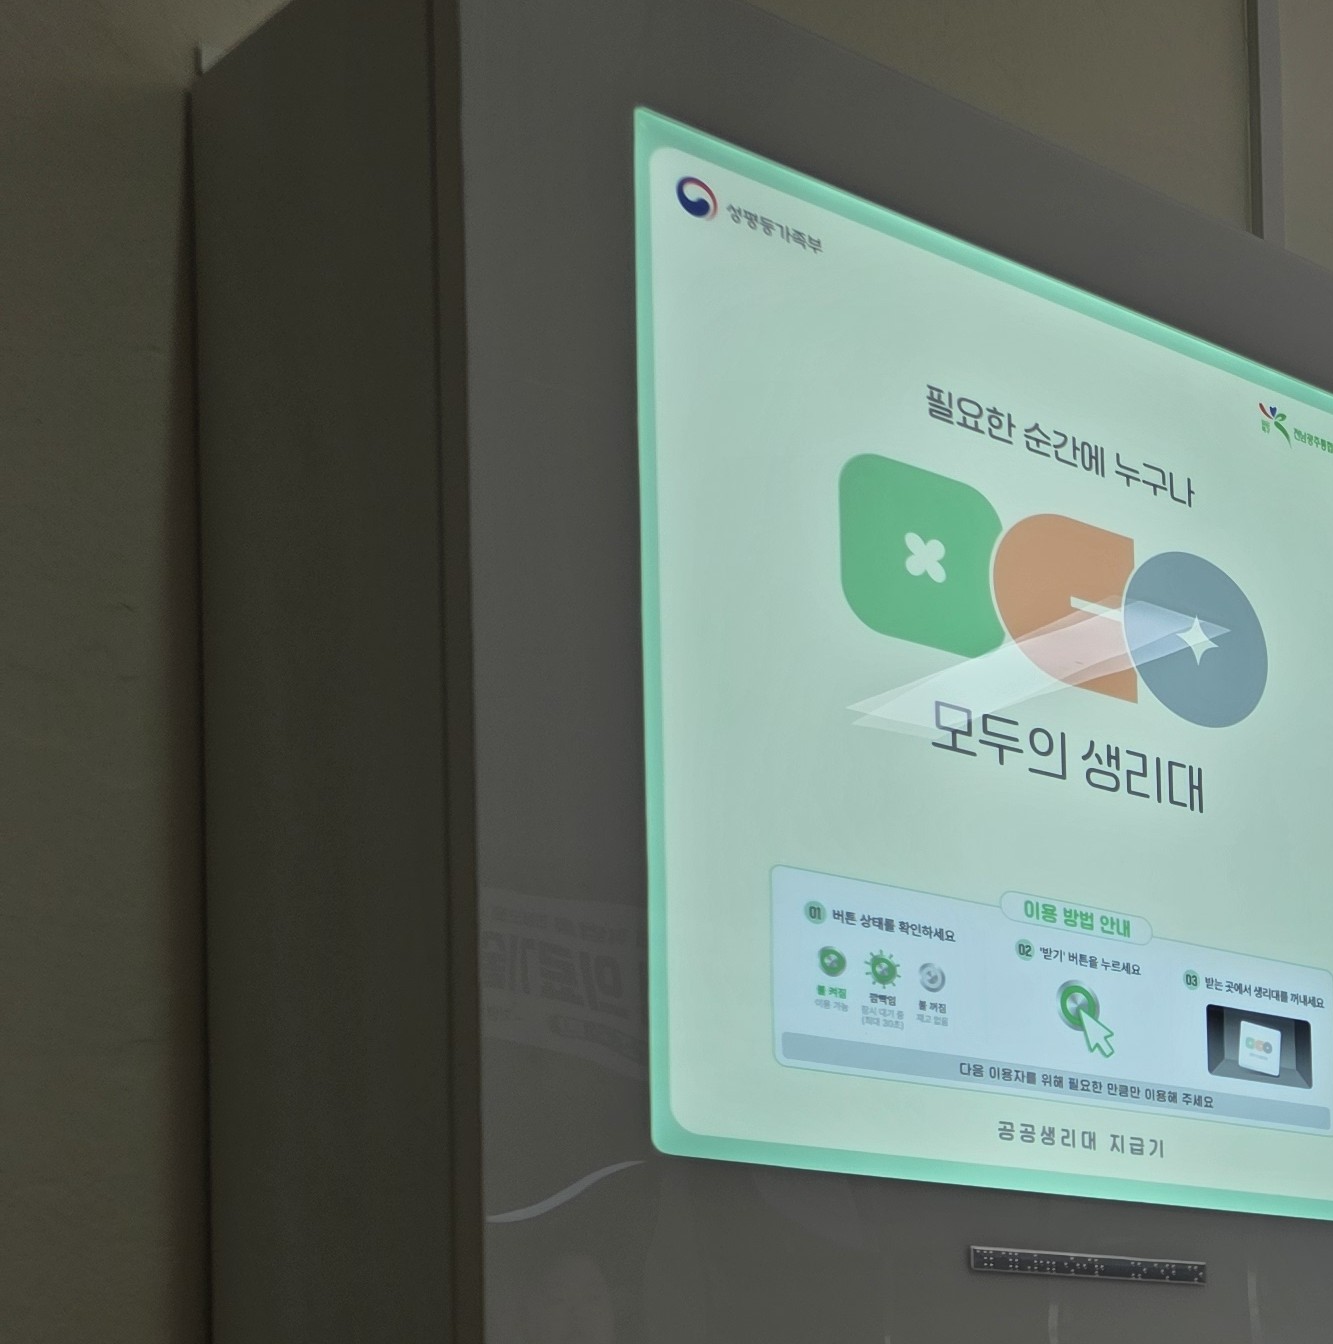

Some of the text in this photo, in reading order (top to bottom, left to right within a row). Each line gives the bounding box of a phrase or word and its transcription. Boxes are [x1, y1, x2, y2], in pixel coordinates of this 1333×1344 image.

[926, 384, 1195, 508] 필요한 순간에 누구나
[931, 700, 1203, 813] 모두의 생리대
[809, 906, 956, 942] 01 버튼 상태를 확인하세요
[1024, 900, 1131, 938] 이용 방법 안내
[1018, 944, 1032, 957] 02
[1068, 952, 1098, 969] 버튼을
[1101, 958, 1141, 975] 누르세요
[1185, 974, 1325, 1008] 03 받는 곳에서 생리대를 꺼내세요
[959, 1062, 1214, 1109] 다음 이용자를 위해 필요한 만큼만 이용해 주세요
[997, 1120, 1165, 1159] 공공생리대 지급기
